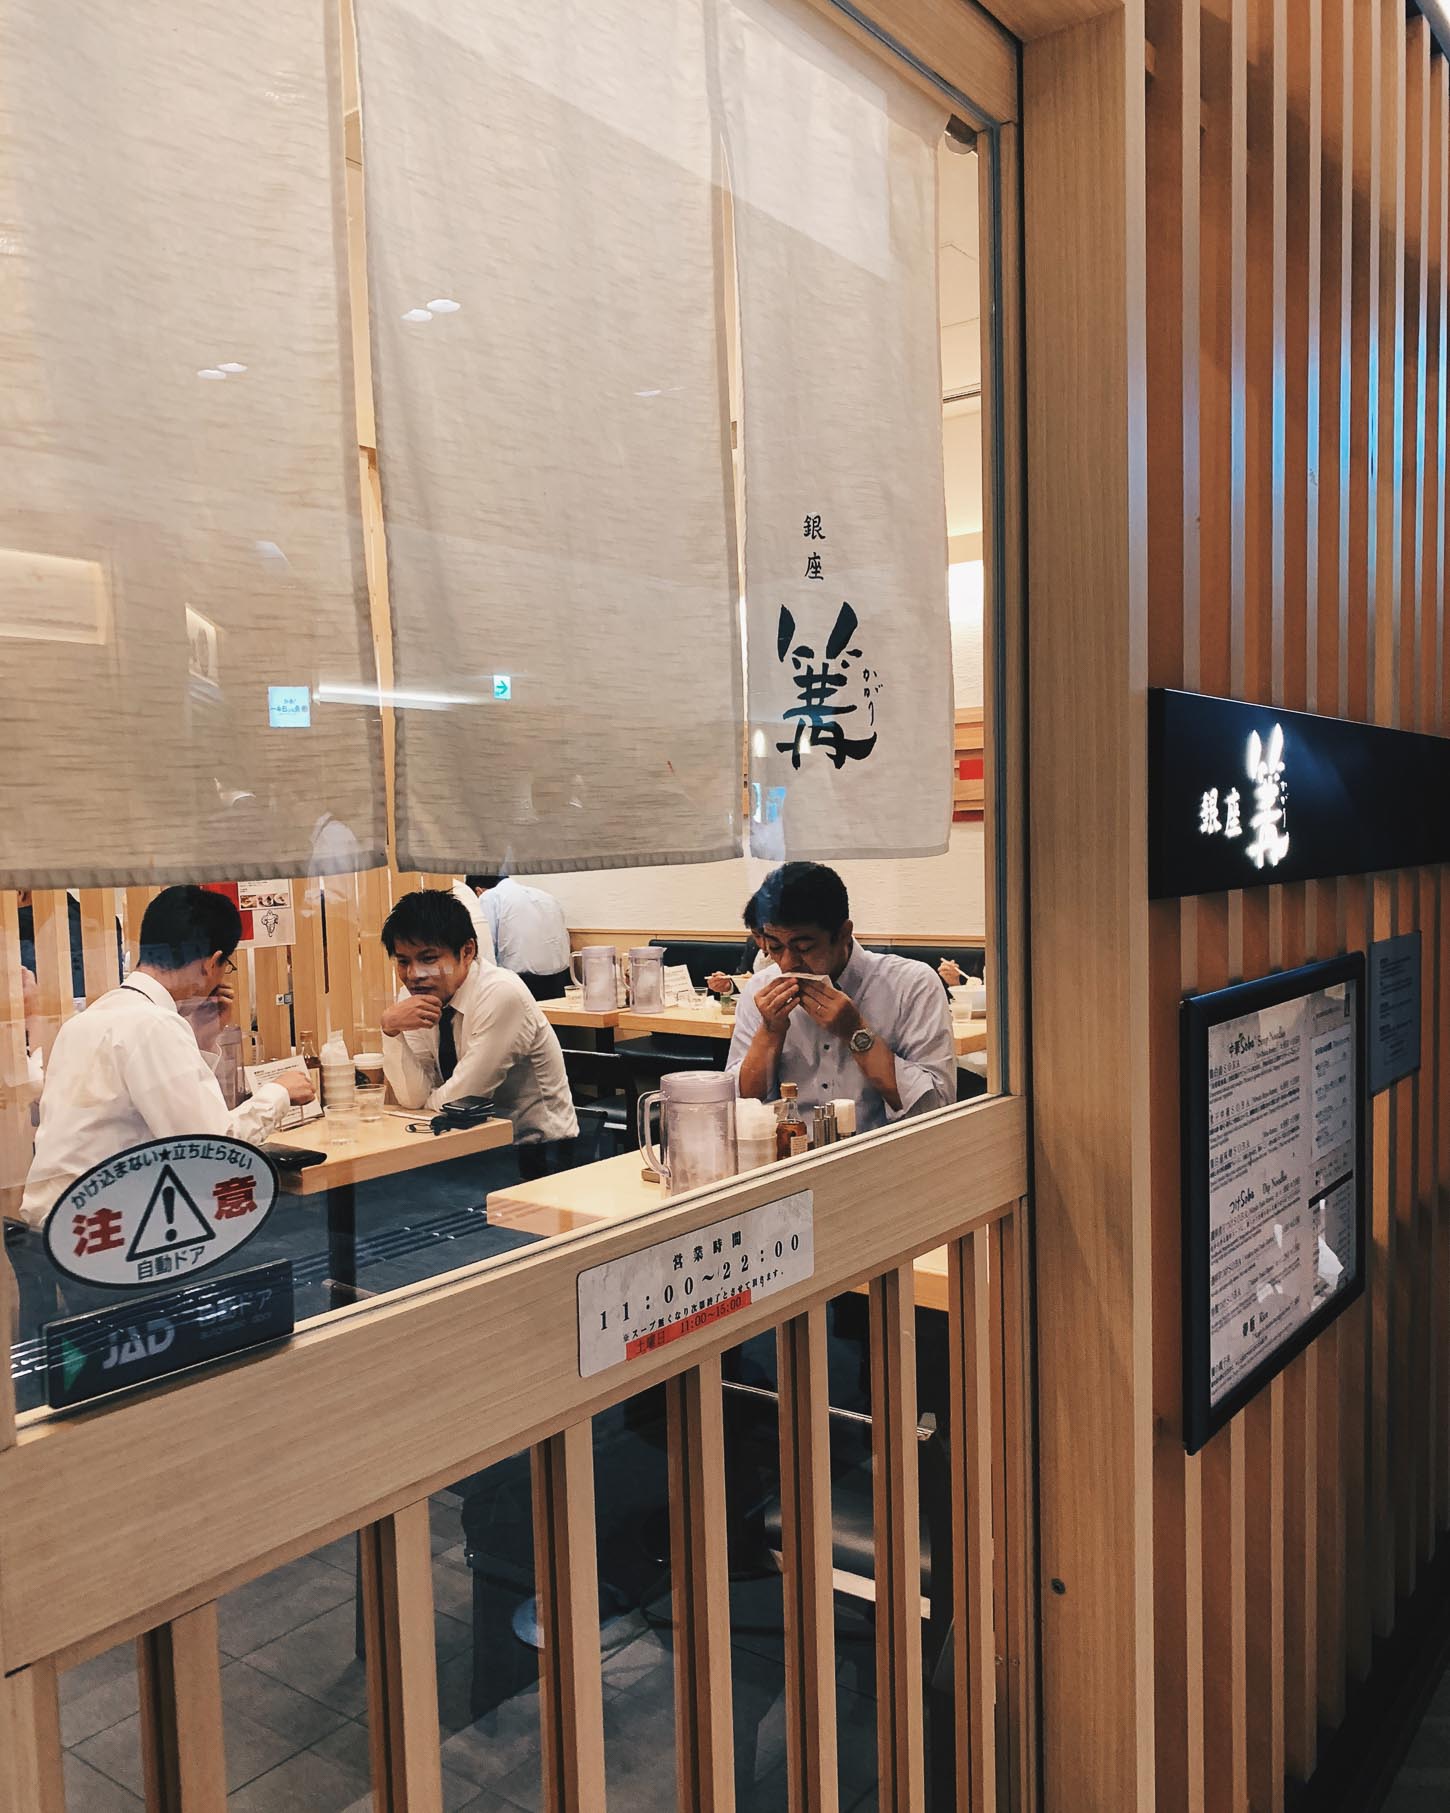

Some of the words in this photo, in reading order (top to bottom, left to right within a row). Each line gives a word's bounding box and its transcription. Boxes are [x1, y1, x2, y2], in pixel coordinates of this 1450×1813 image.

[802, 514, 826, 581] 銀座
[862, 668, 883, 727] かがり
[1198, 787, 1243, 838] 銀座
[137, 1245, 207, 1281] 自動ドア
[672, 1230, 743, 1272] 営業時間
[102, 1317, 175, 1370] JAD
[636, 1331, 667, 1355] 土曜日
